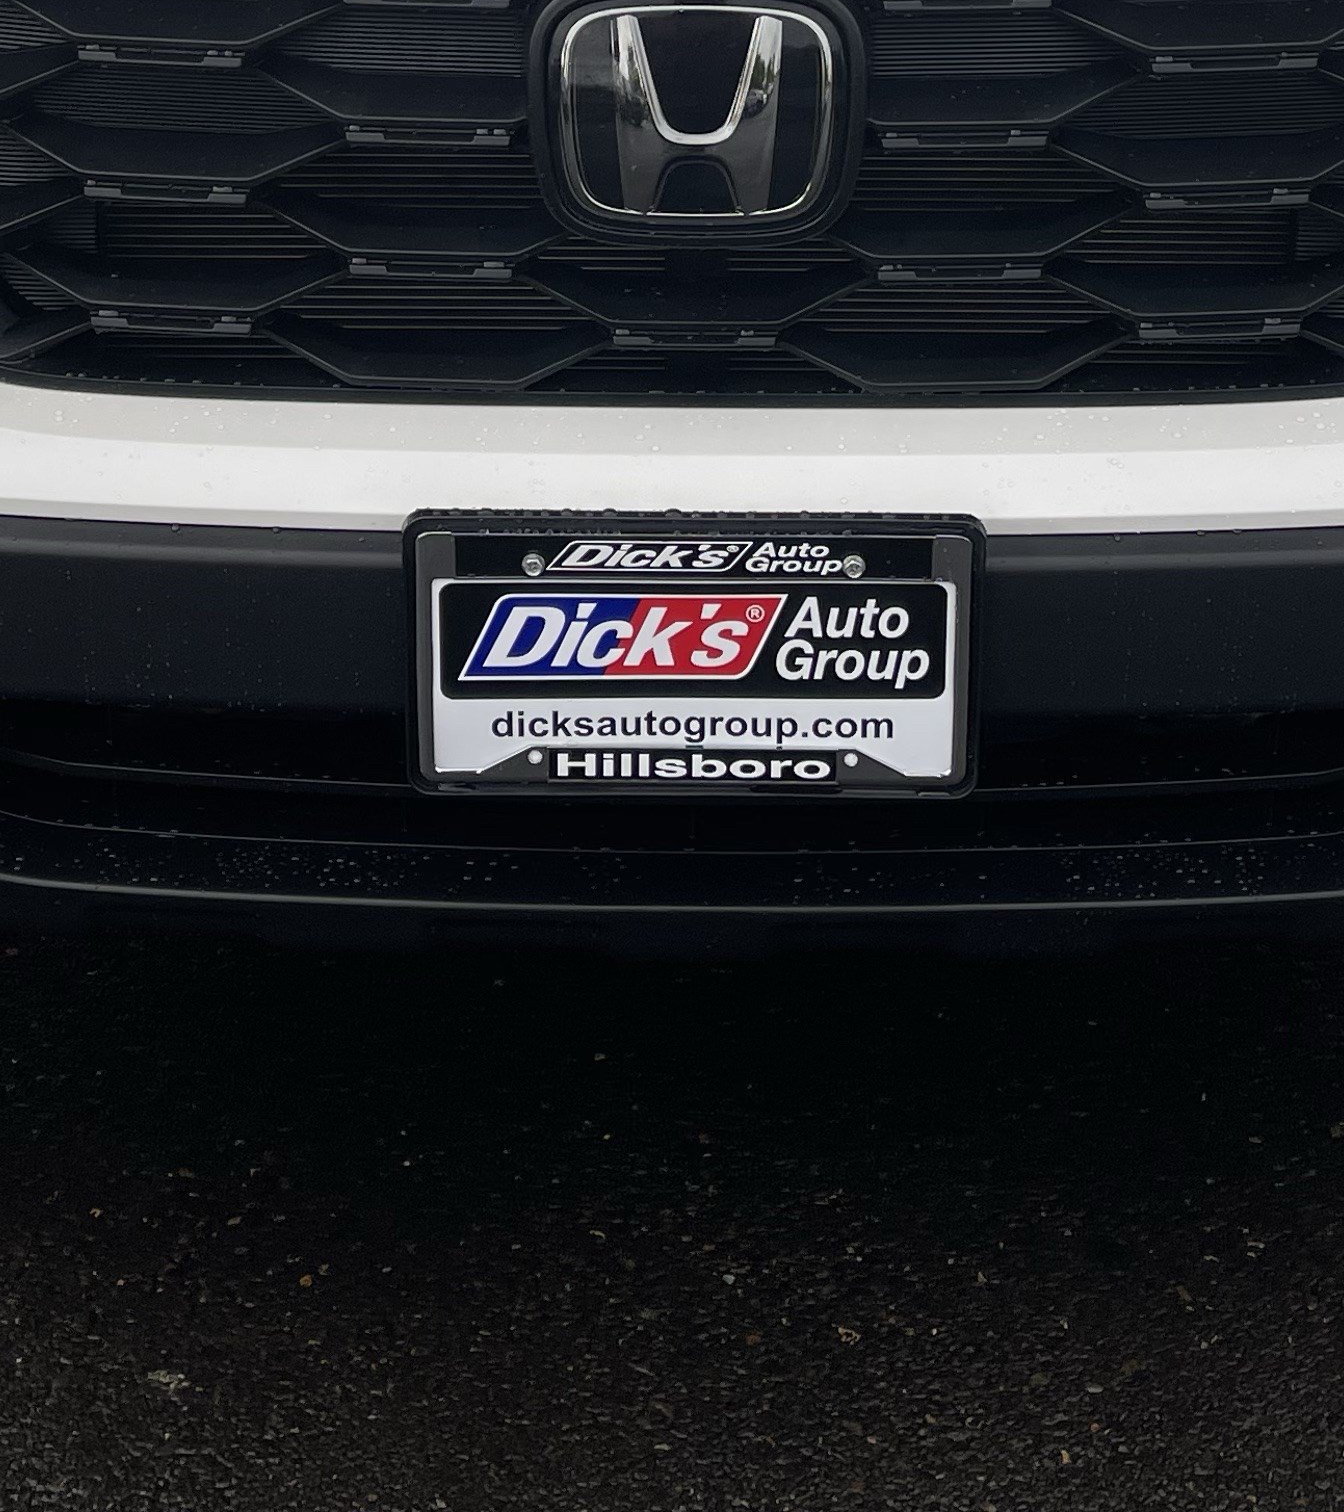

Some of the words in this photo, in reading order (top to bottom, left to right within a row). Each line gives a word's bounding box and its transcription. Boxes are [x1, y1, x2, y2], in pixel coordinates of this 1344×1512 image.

[744, 557, 844, 576] Group
[752, 542, 830, 558] Auto
[784, 596, 910, 640] Auto
[775, 639, 931, 690] Group
[490, 709, 895, 746] dicksautogroup.com
[555, 751, 834, 780] Hillsboro
